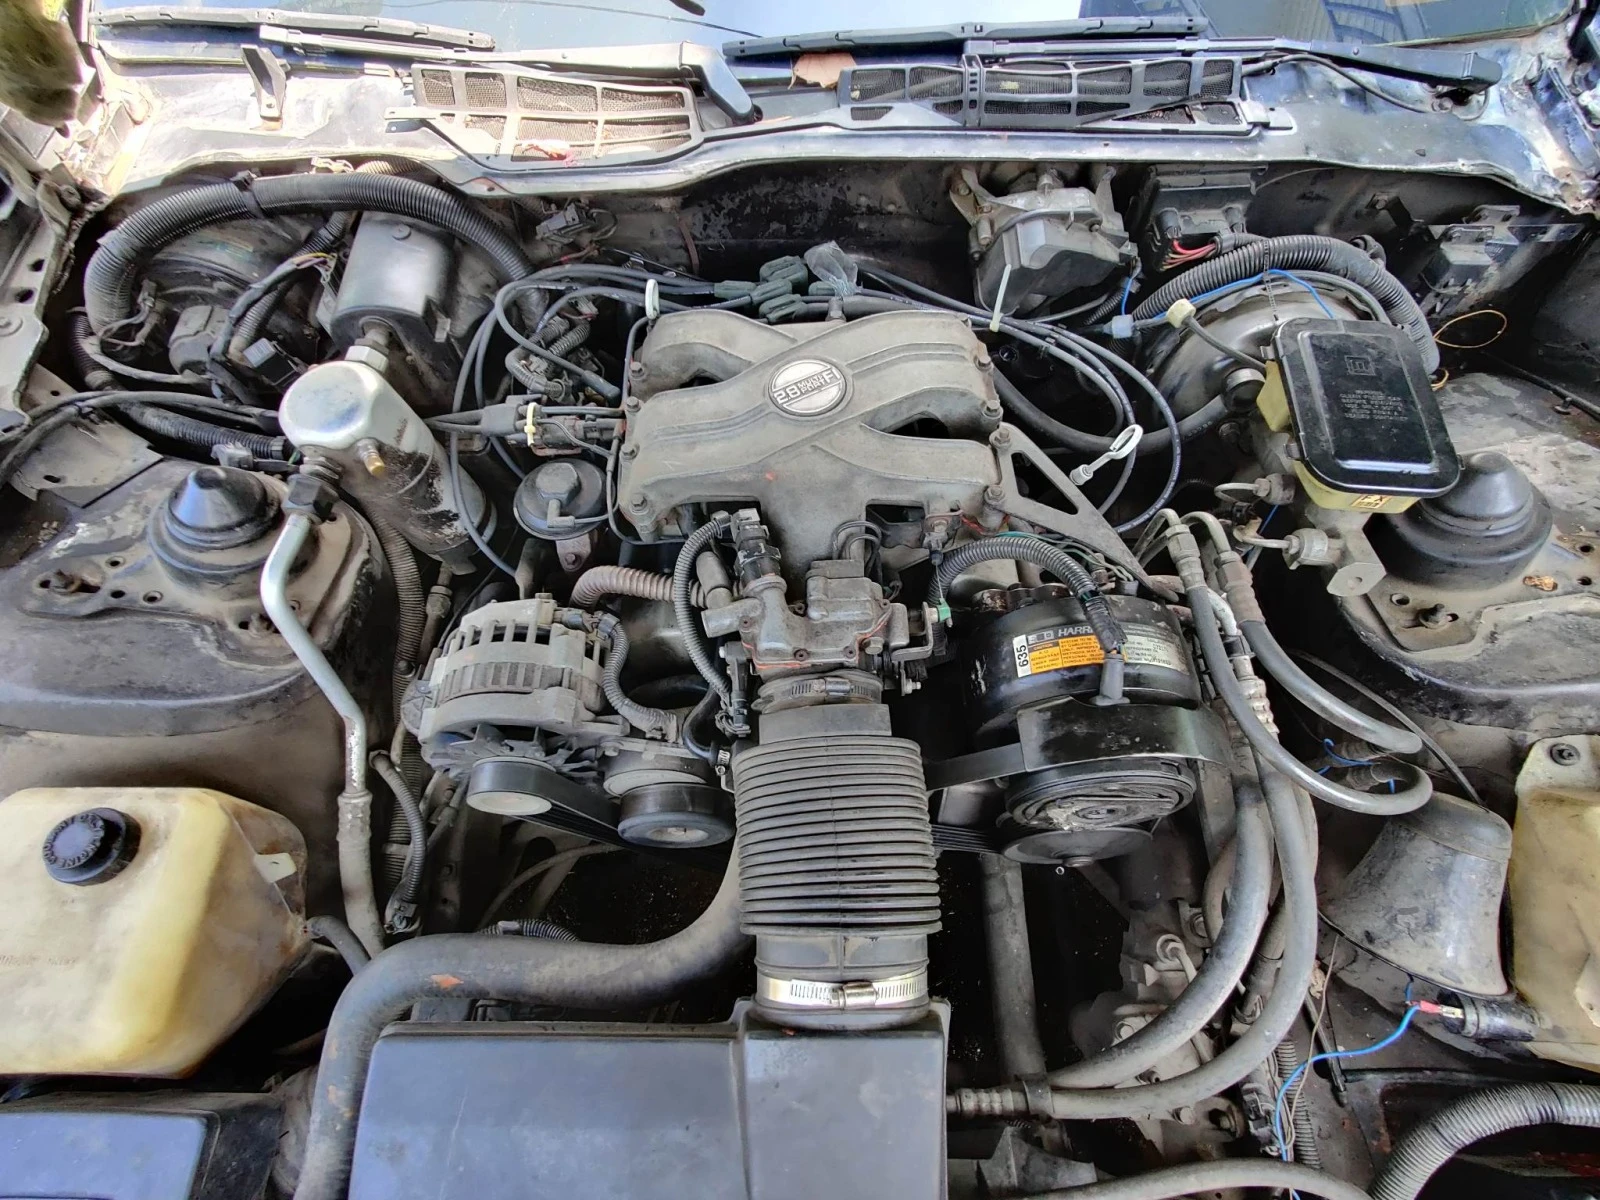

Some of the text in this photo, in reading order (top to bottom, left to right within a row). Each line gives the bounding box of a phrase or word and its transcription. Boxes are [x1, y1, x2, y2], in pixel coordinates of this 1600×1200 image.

[797, 373, 823, 388] MULTI
[823, 367, 841, 384] FI
[773, 385, 801, 405] 2.8
[801, 379, 828, 394] PORT
[1017, 645, 1029, 667] 635
